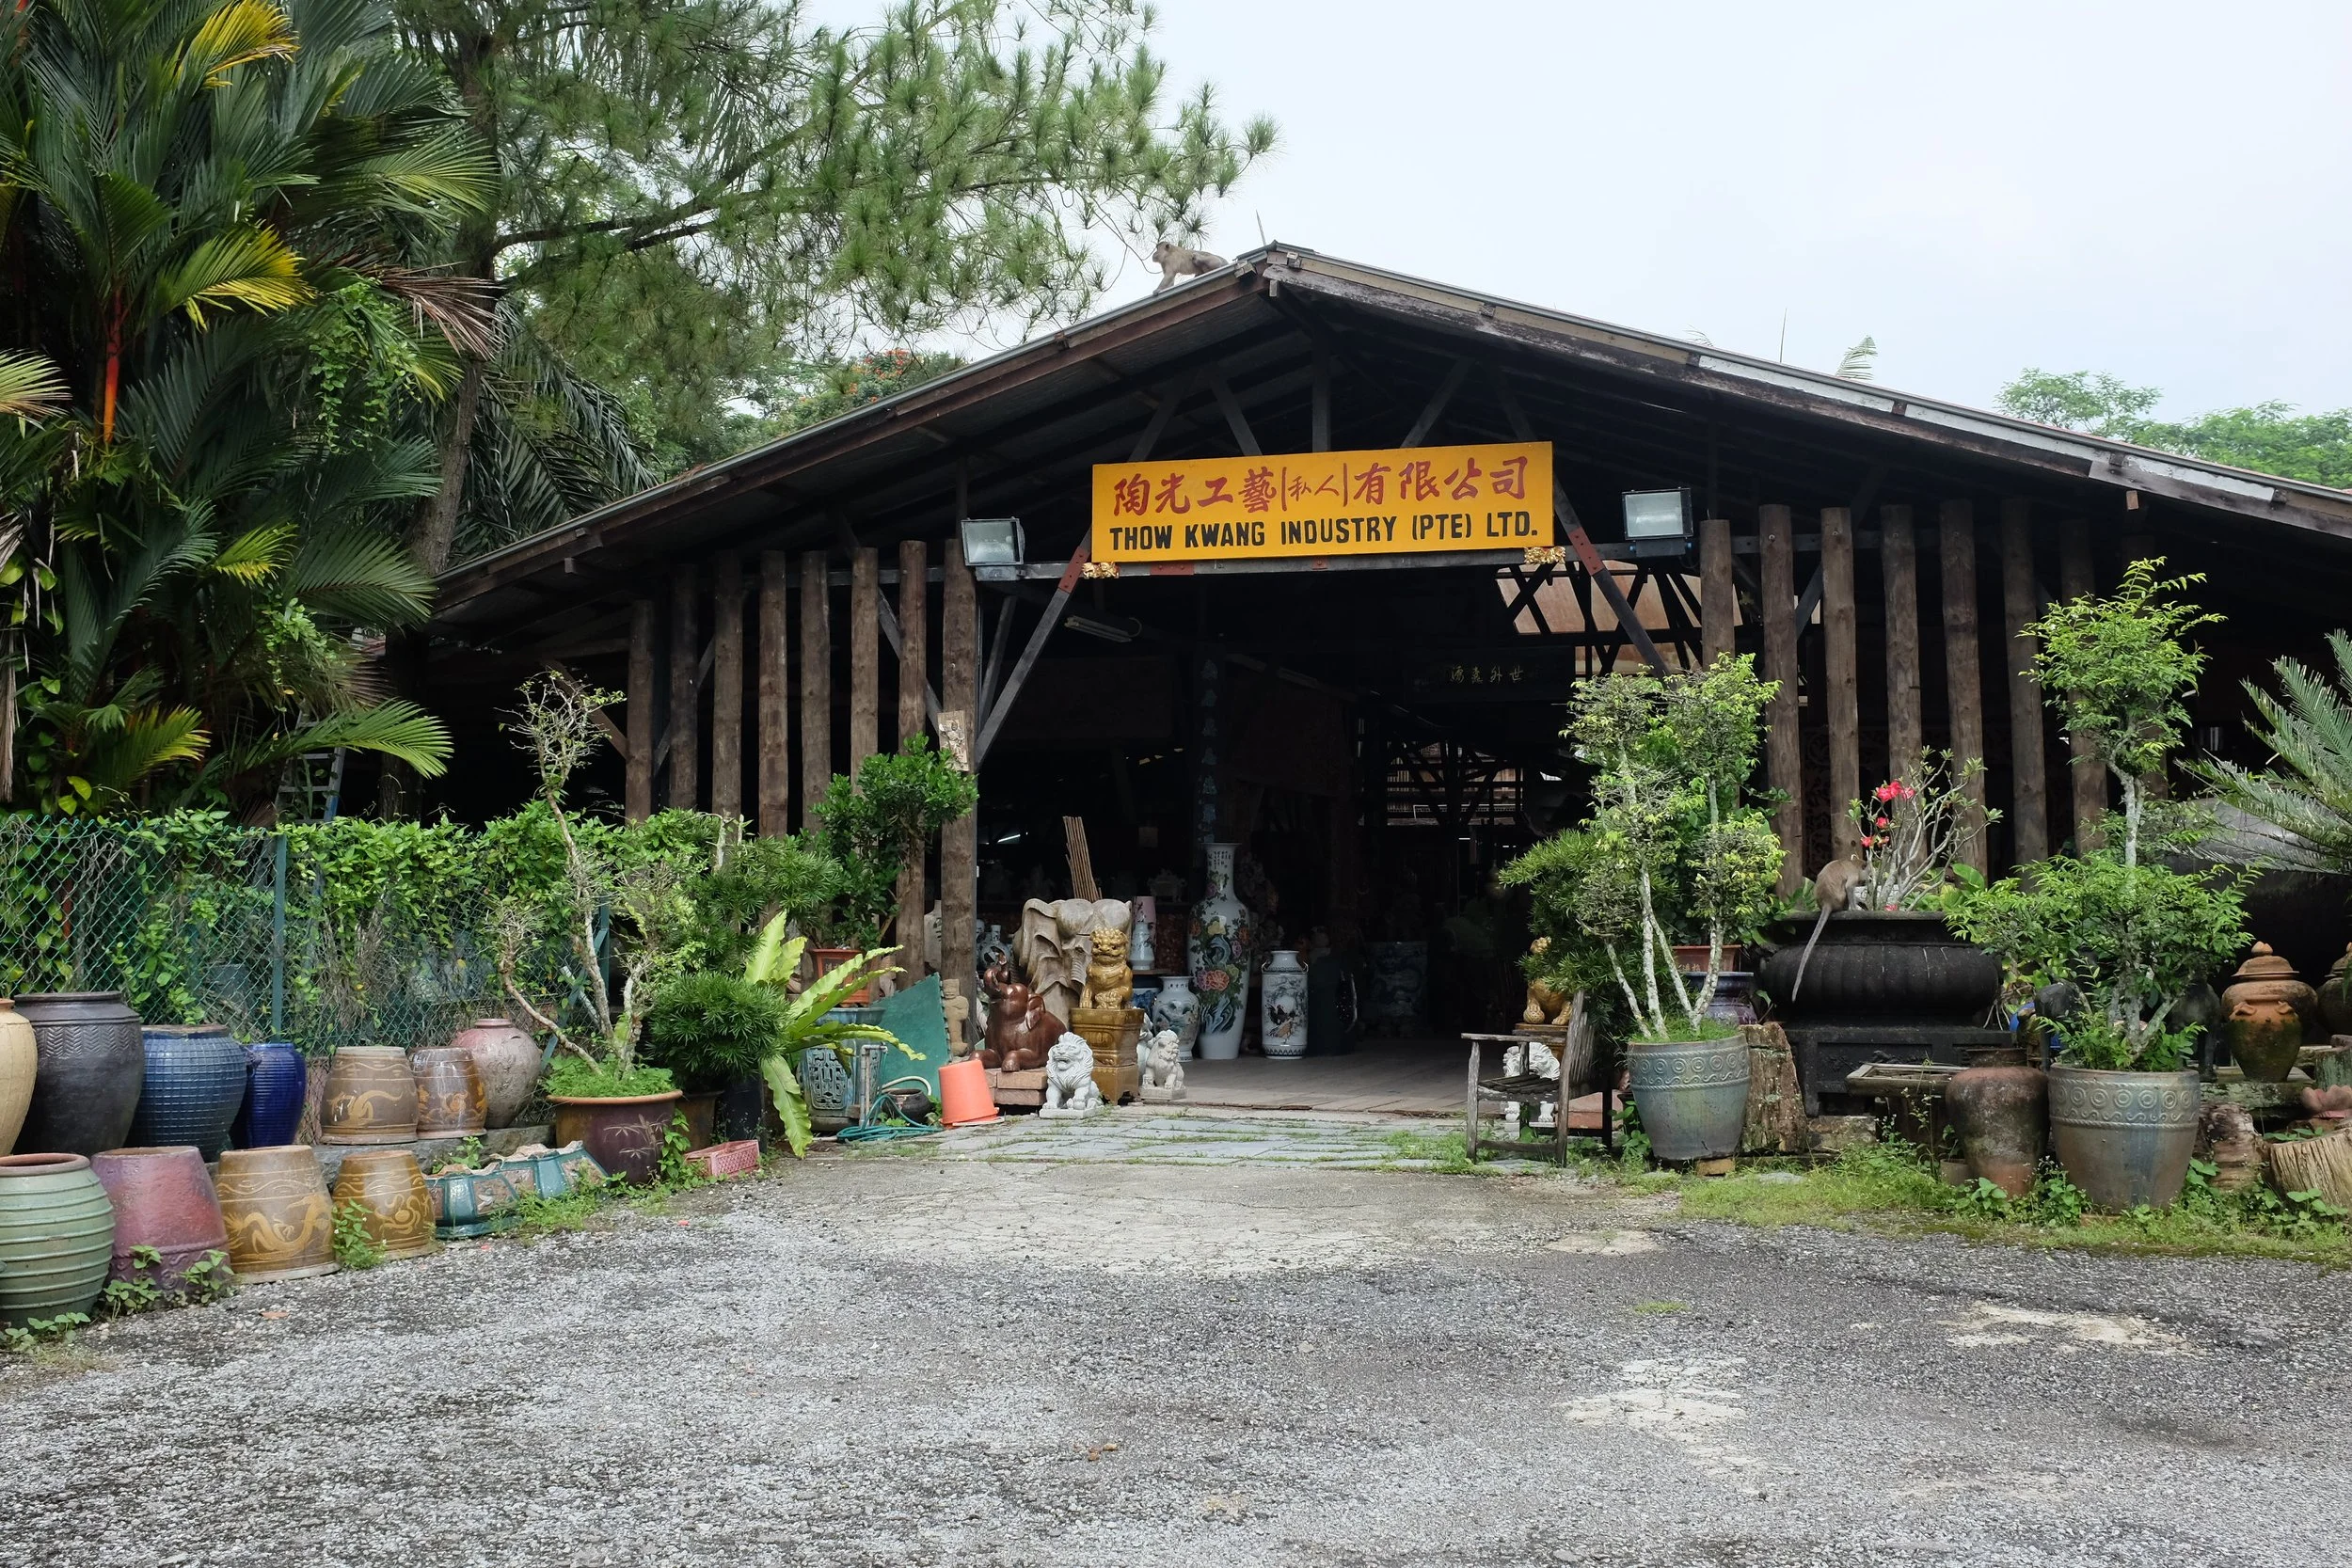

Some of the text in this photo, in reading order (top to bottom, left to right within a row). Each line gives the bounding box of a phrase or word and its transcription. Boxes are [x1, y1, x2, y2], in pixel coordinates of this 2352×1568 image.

[1110, 511, 1538, 550] THOW KWANG INDUSTRY (PTE) LTD.
